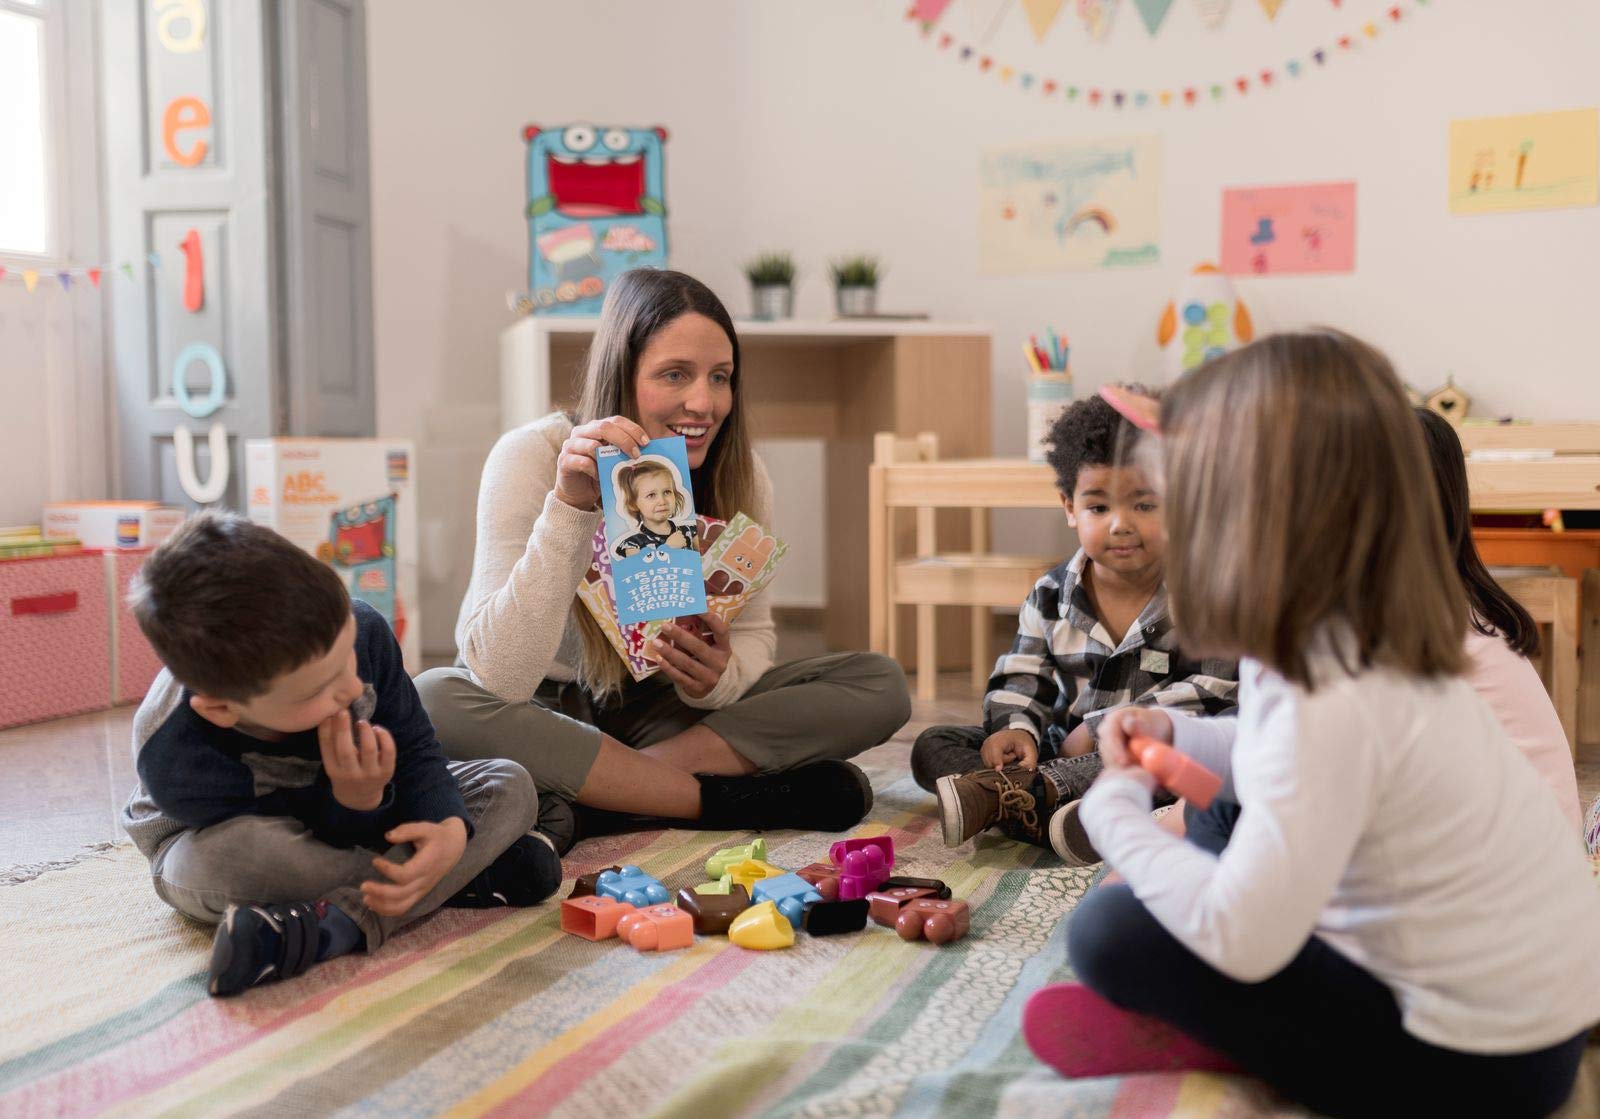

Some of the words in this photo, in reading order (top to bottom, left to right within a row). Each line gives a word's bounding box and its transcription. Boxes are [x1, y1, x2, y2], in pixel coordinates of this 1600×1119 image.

[163, 96, 212, 168] e
[622, 568, 694, 584] TRISTE
[640, 574, 678, 584] SAD
[628, 580, 690, 596] TRISTE
[632, 587, 688, 602] TRISTE
[637, 600, 686, 613] TRISTE
